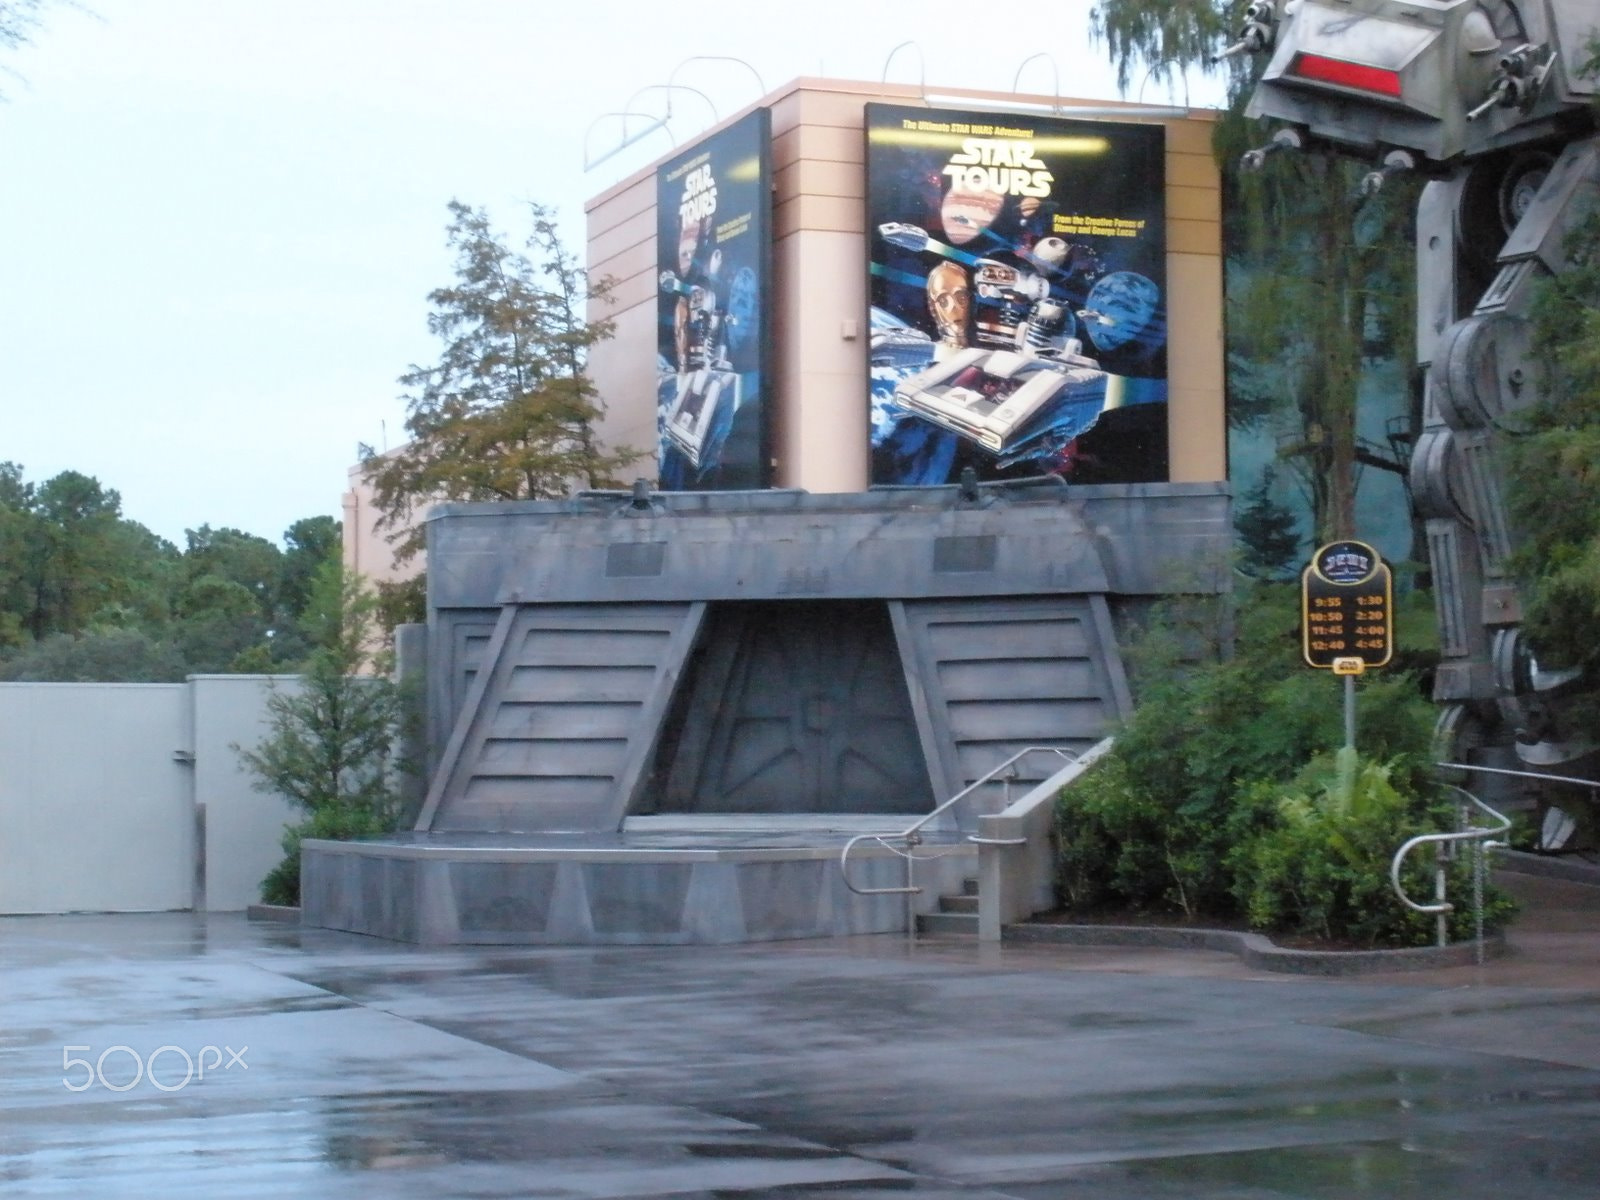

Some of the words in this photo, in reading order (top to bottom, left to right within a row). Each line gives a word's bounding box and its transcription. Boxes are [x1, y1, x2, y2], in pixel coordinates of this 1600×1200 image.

[903, 119, 917, 130] The
[918, 120, 949, 133] Ultimate
[950, 123, 970, 134] STAR
[971, 125, 993, 135] WARS
[950, 138, 1046, 169] STAR
[682, 164, 715, 202] STAR
[942, 165, 1054, 198] TOURS
[679, 187, 717, 229] TOURS
[1053, 213, 1071, 224] From
[1072, 216, 1084, 225] the
[1085, 216, 1114, 227] Creative
[1114, 218, 1136, 228] Forces
[1137, 220, 1145, 228] of
[1053, 223, 1078, 234] Disney
[1078, 226, 1091, 234] and
[1092, 226, 1116, 236] George
[1116, 228, 1137, 237] Lucas
[1357, 596, 1383, 606] 1:30
[1355, 626, 1385, 635] 4:00
[1355, 639, 1383, 649] 4:45
